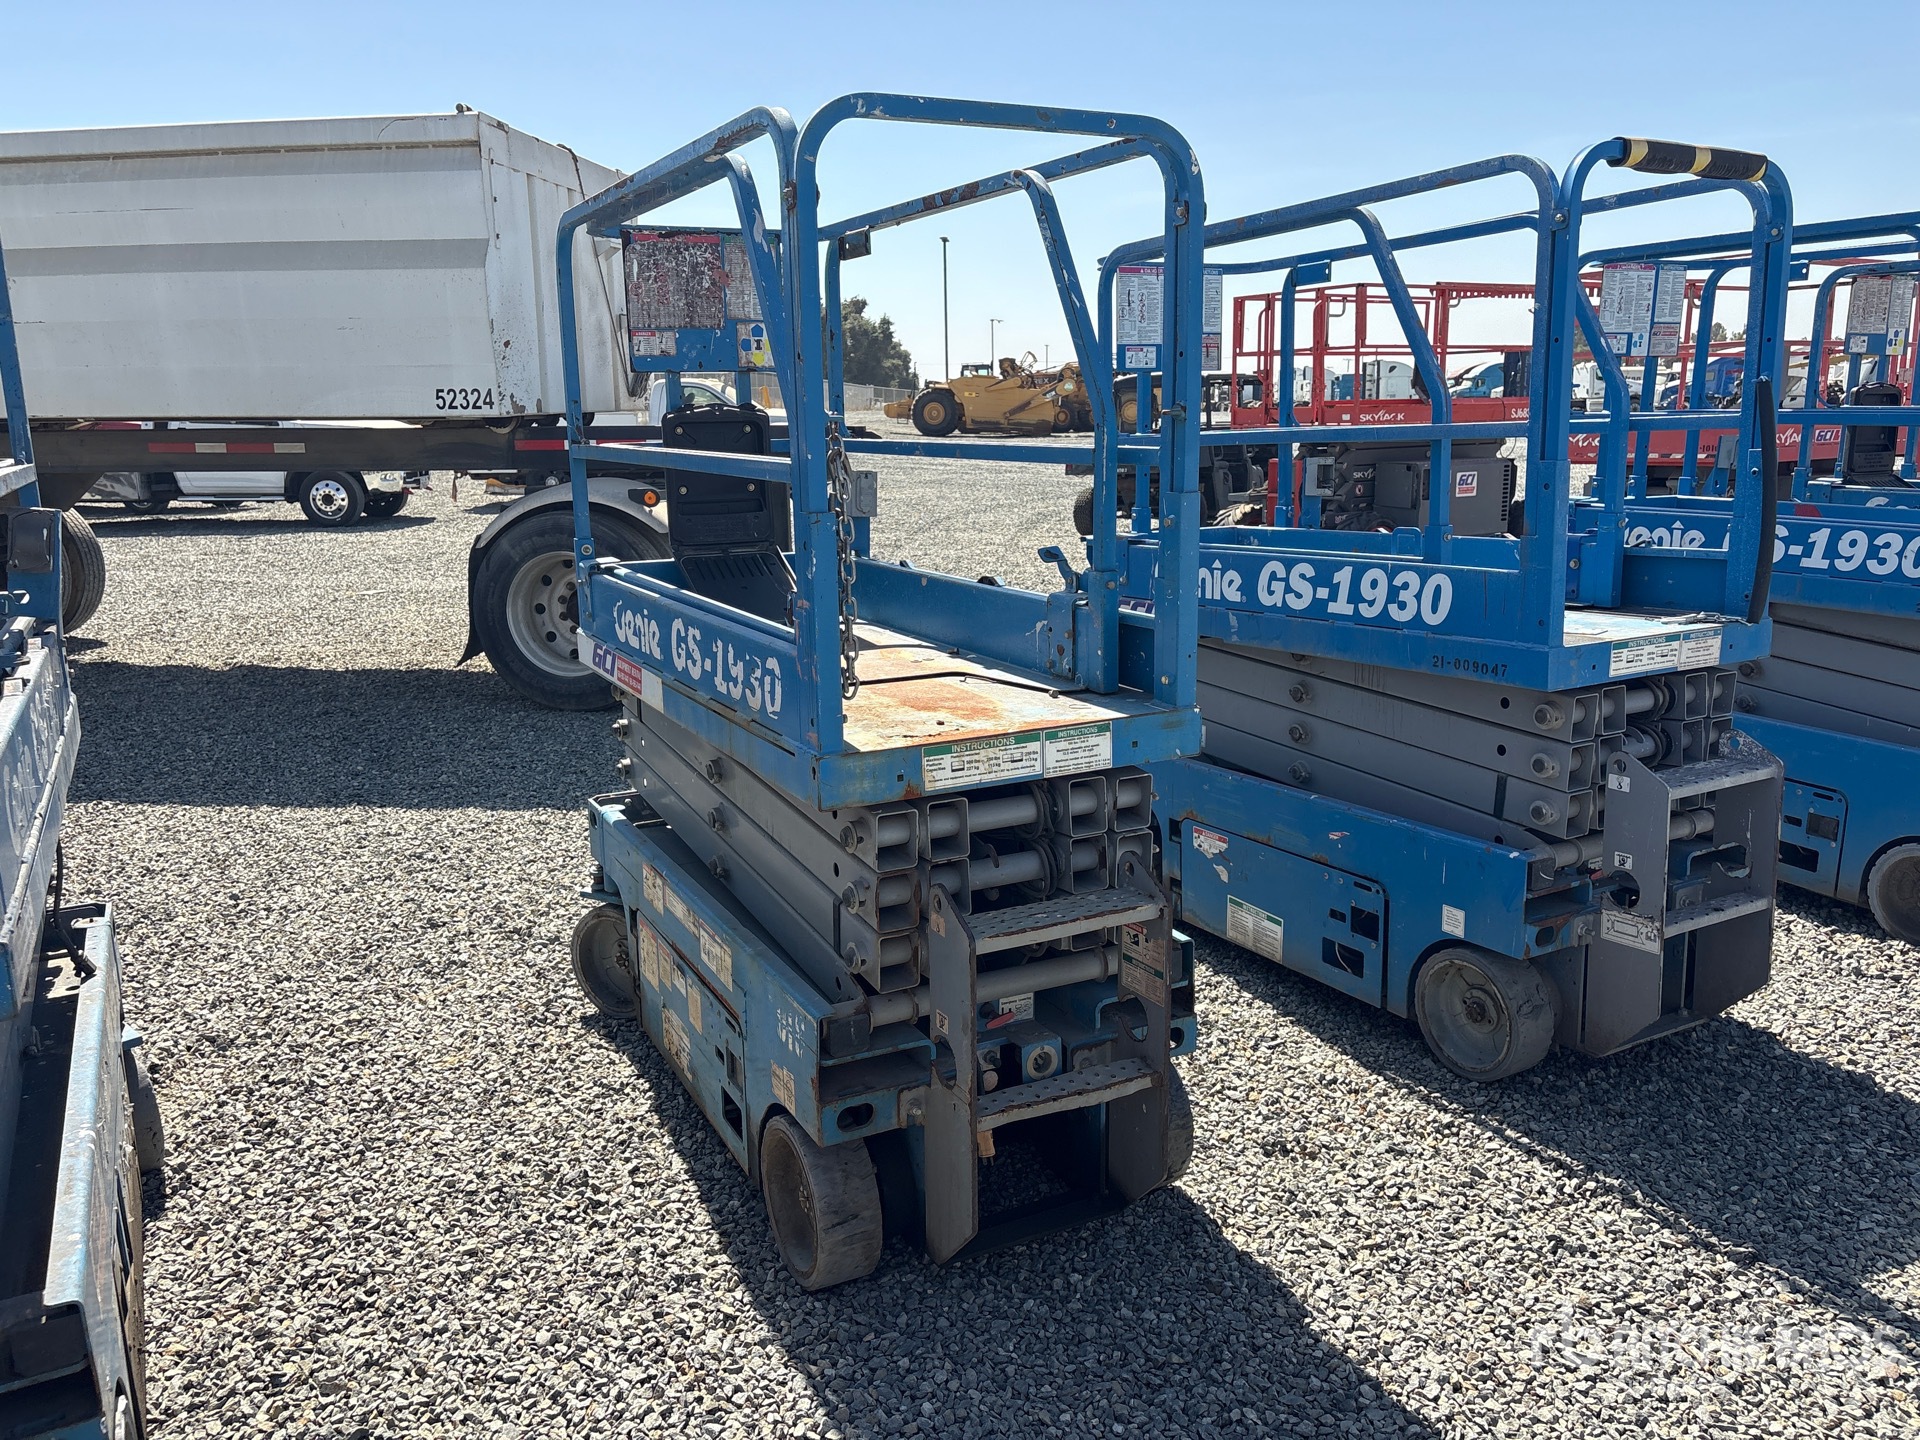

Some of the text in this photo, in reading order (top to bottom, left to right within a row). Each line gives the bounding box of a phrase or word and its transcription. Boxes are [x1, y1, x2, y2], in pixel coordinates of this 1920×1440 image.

[435, 388, 495, 410] 52324
[1360, 409, 1405, 422] SKYJACK
[1458, 473, 1476, 486] GCI
[1624, 520, 1706, 548] enie
[1257, 560, 1453, 625] GS-1930
[613, 600, 661, 660] Genie
[1628, 637, 1666, 647] INSTRUCTIONS
[593, 643, 617, 677] GCI
[1432, 655, 1508, 677] 21-009047
[1058, 727, 1098, 737] INSTRUCTIONS
[951, 737, 1015, 753] INSTRUCTIONS
